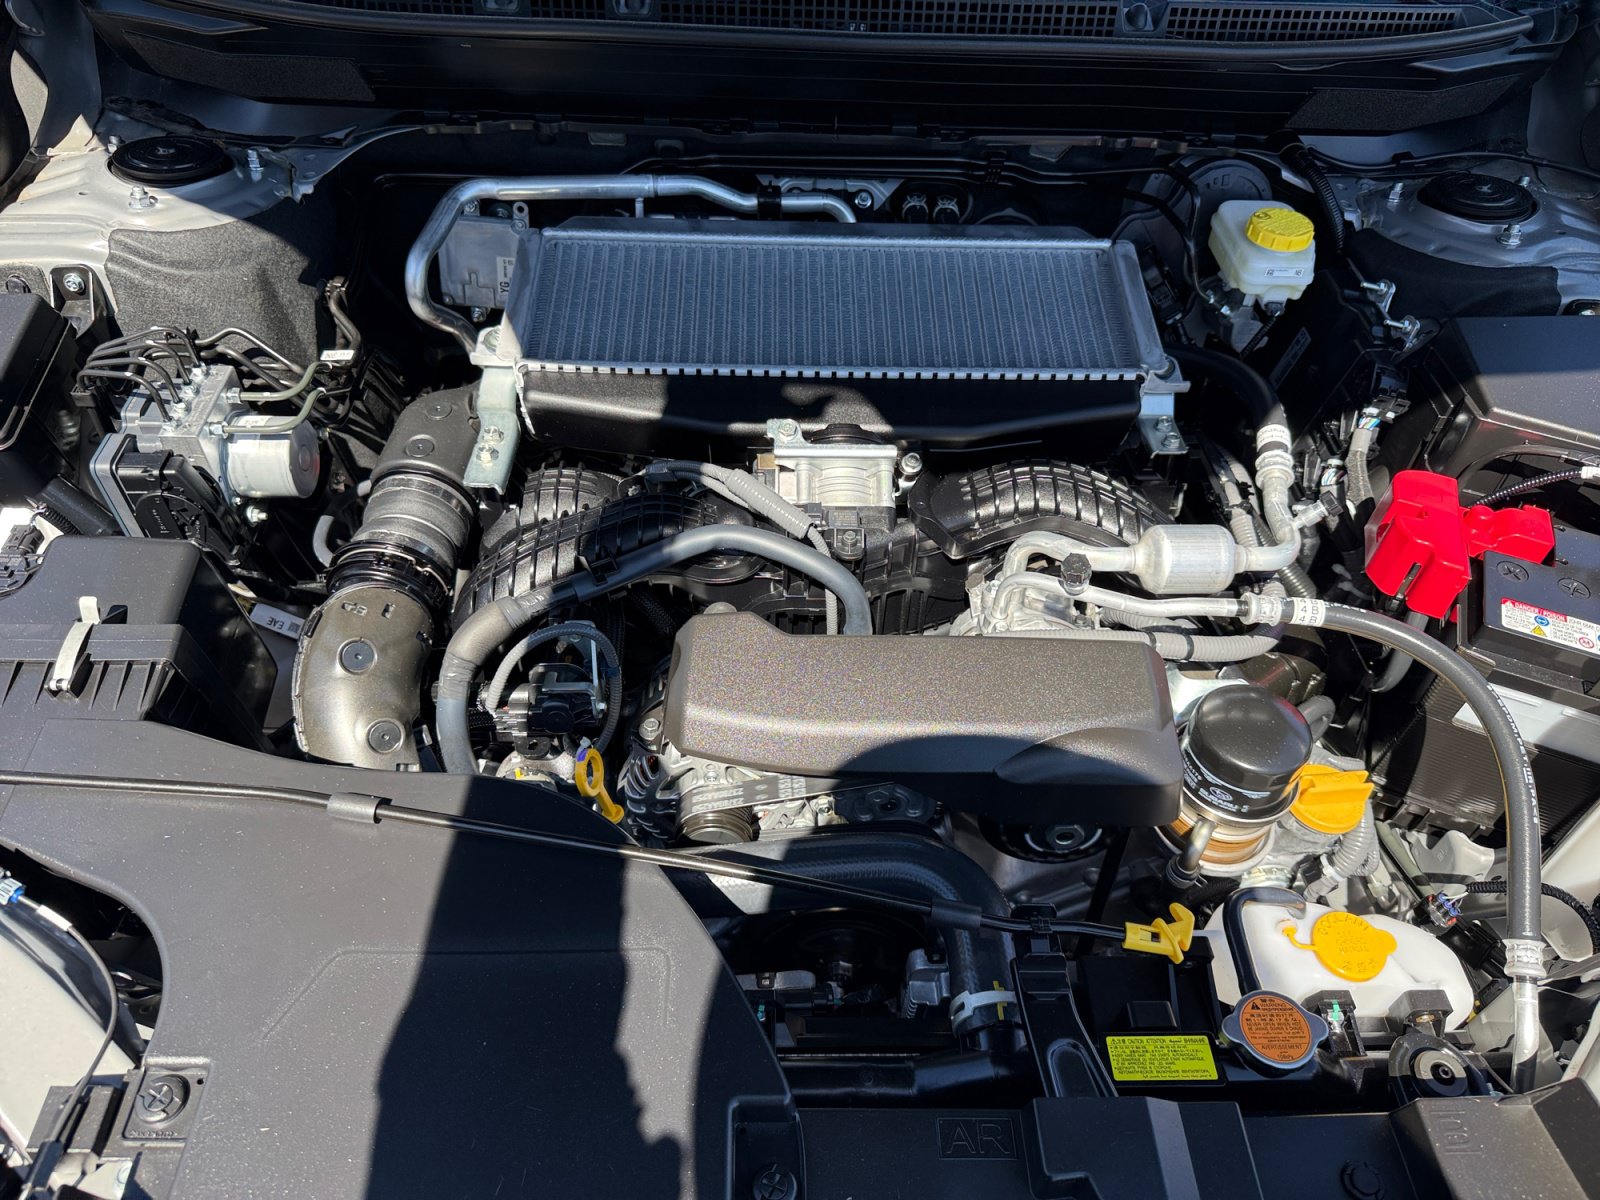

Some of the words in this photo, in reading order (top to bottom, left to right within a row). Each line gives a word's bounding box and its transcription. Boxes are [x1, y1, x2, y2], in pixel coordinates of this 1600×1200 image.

[500, 282, 510, 293] YG
[1514, 602, 1539, 614] DANGER
[1543, 610, 1565, 623] POISON
[266, 616, 285, 630] EAE
[946, 1120, 1011, 1154] AR
